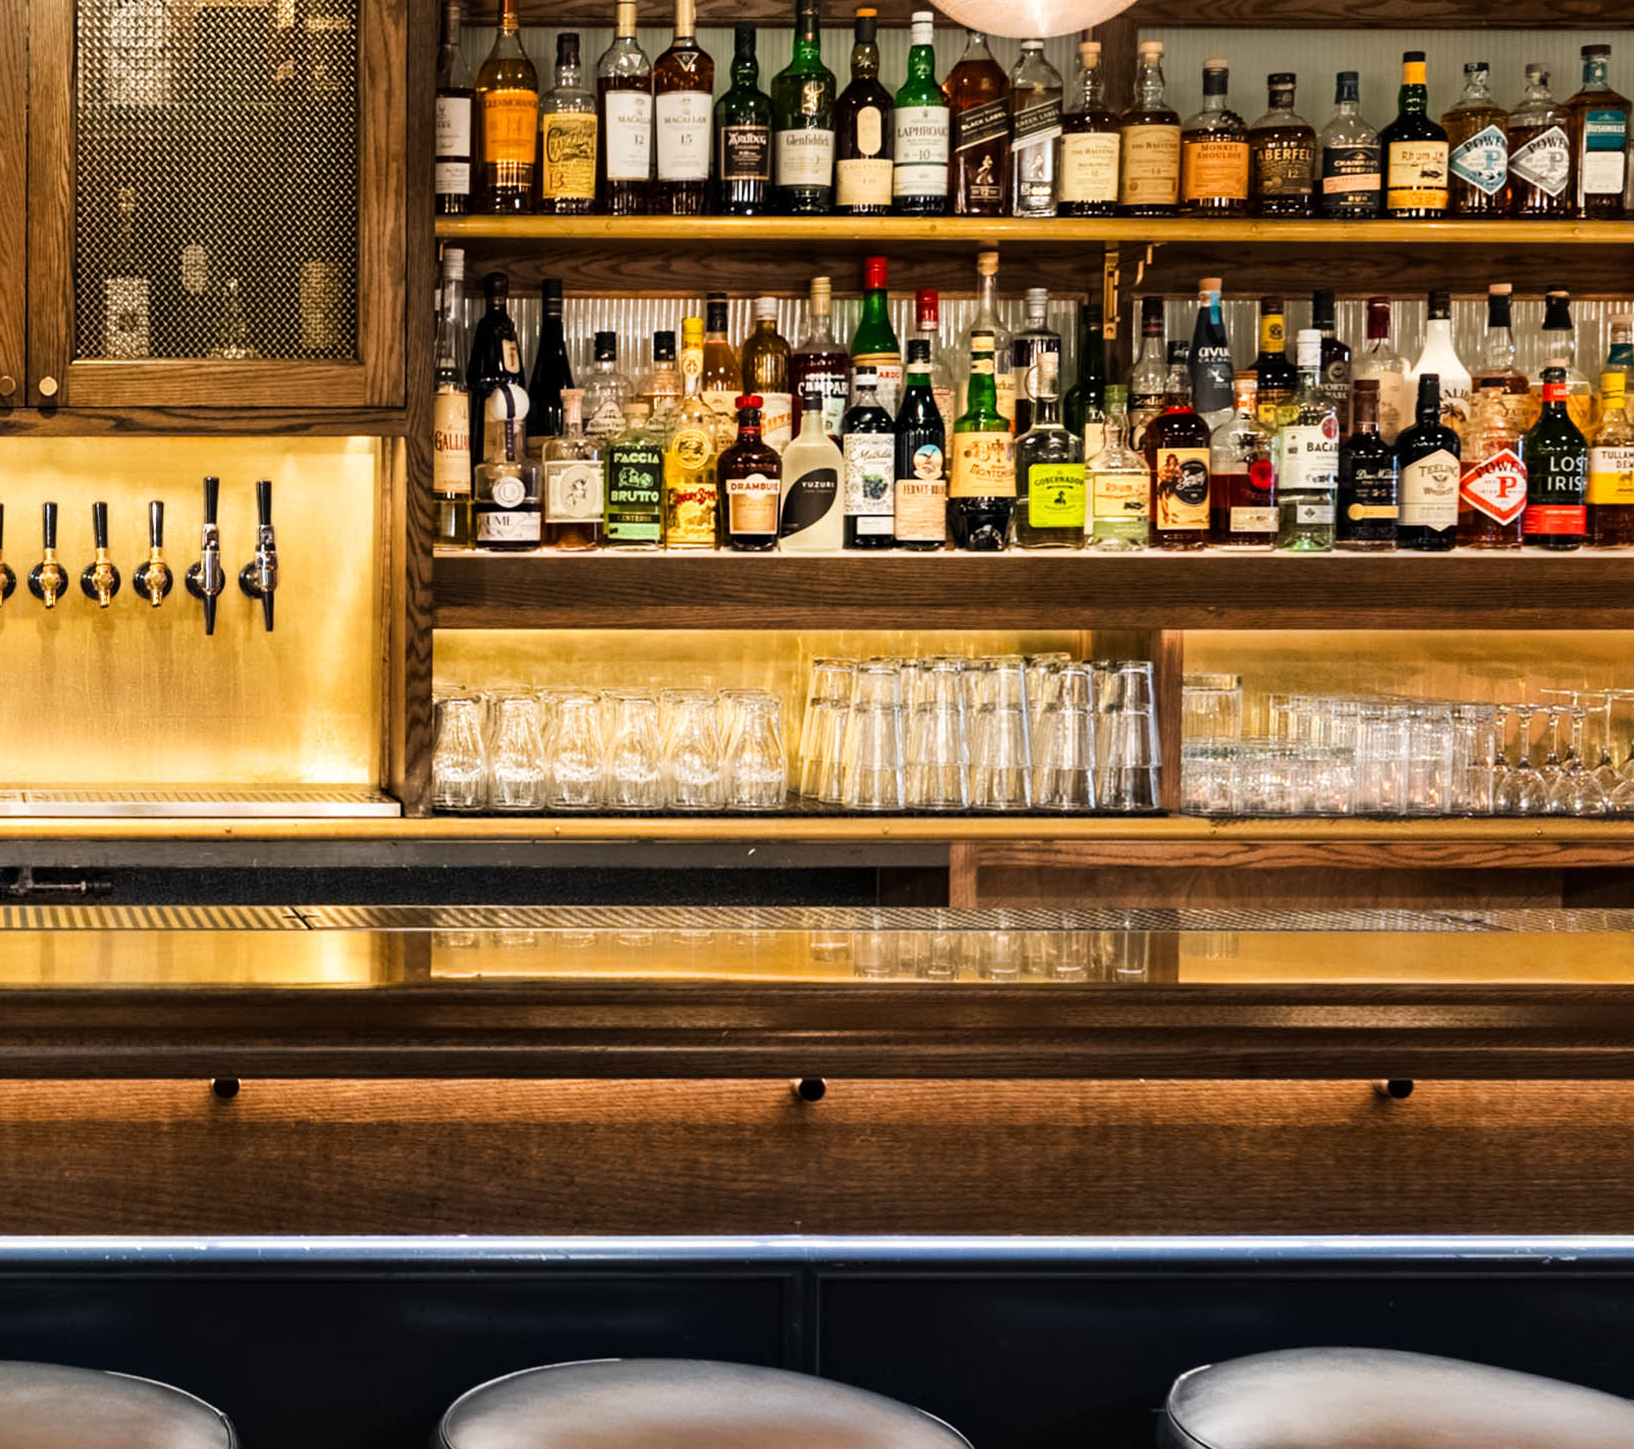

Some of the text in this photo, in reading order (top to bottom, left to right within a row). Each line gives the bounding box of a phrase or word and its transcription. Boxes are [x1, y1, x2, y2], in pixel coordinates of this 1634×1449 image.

[664, 115, 707, 124] MACALLAN
[961, 110, 1007, 130] BLACK LABEL
[1587, 123, 1626, 133] BUSHMILLS
[634, 134, 644, 144] 12
[680, 134, 693, 144] 15
[728, 133, 767, 146] ARDBEG
[919, 149, 930, 160] 10
[1257, 149, 1312, 160] ABERFEL
[1483, 149, 1502, 170] P
[1544, 149, 1560, 171] P
[548, 172, 564, 188] 13
[613, 452, 660, 464] FACCIA
[730, 483, 778, 491] DRAMBUIE
[1496, 476, 1518, 498] P
[611, 490, 659, 502] BRUTTO
